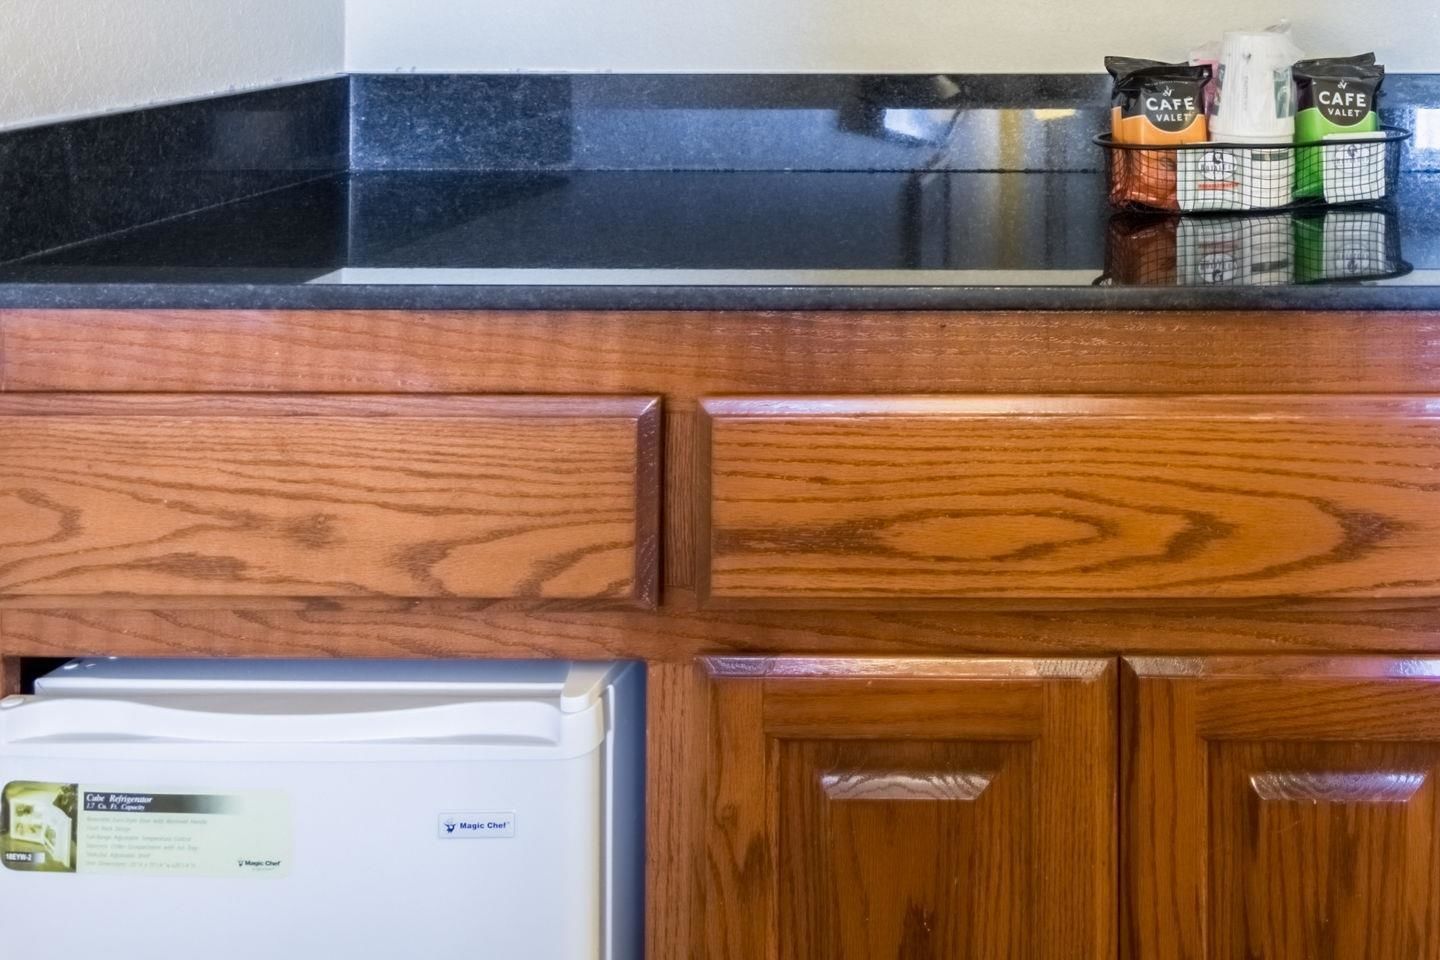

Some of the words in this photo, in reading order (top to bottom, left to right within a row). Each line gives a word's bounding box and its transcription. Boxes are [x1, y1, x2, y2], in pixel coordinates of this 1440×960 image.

[1327, 107, 1361, 117] VALET
[1155, 113, 1190, 122] VALET
[86, 793, 105, 802] Cube
[109, 794, 153, 804] Refrigerator
[121, 803, 145, 812] Capacity
[460, 822, 485, 830] Magic
